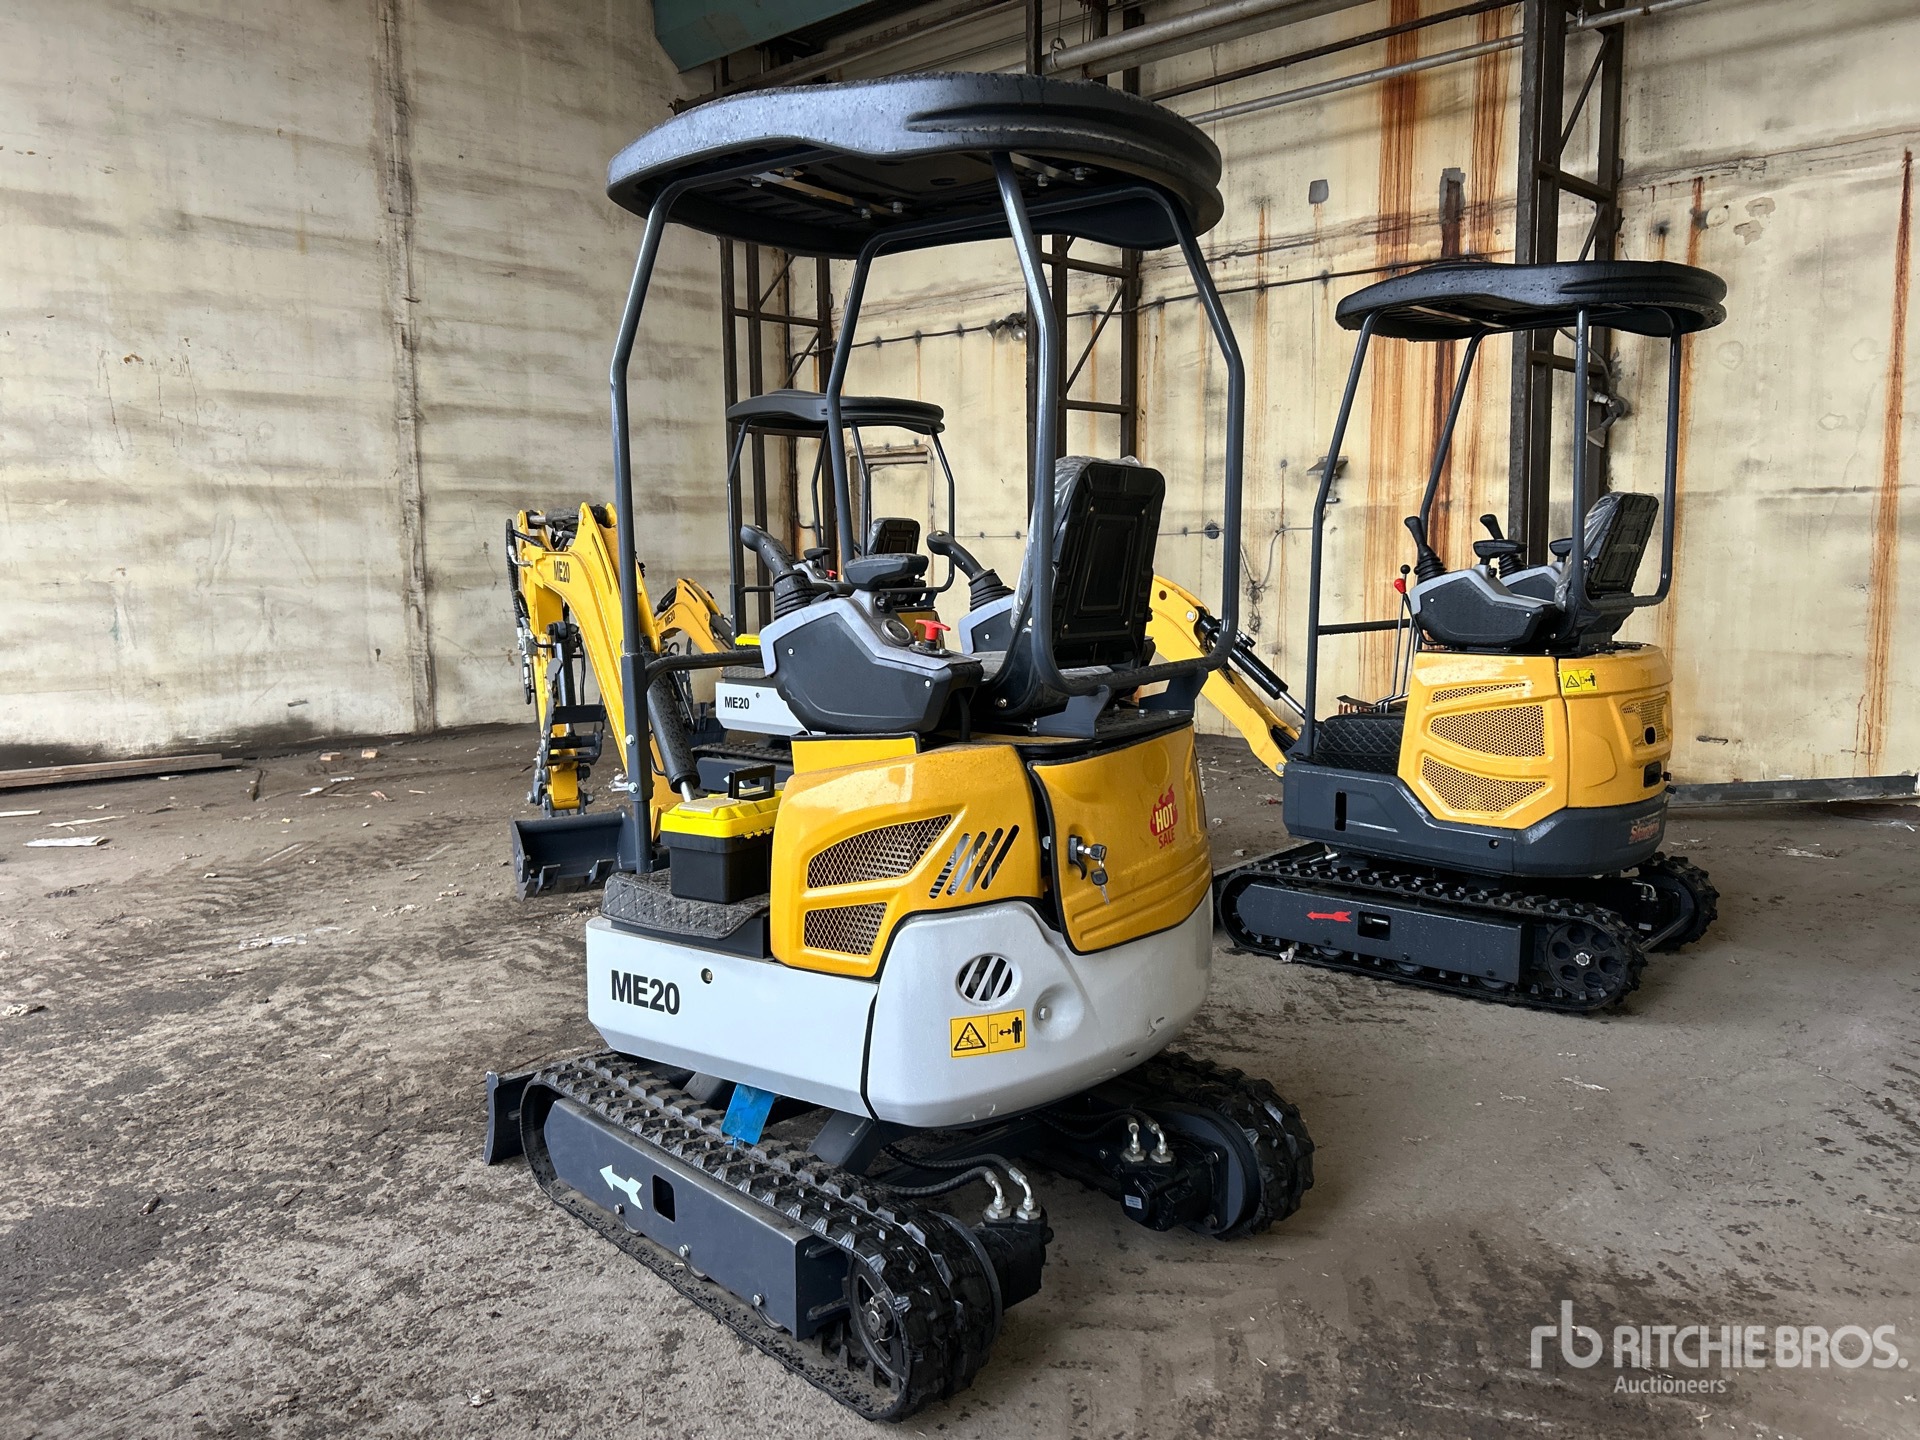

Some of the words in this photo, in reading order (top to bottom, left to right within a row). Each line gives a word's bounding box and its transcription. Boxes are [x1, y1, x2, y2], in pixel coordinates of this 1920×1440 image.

[553, 560, 570, 583] ME20
[724, 695, 750, 710] ME20
[1155, 803, 1174, 833] HOT
[1158, 828, 1175, 849] SALE
[611, 969, 680, 1016] ME20
